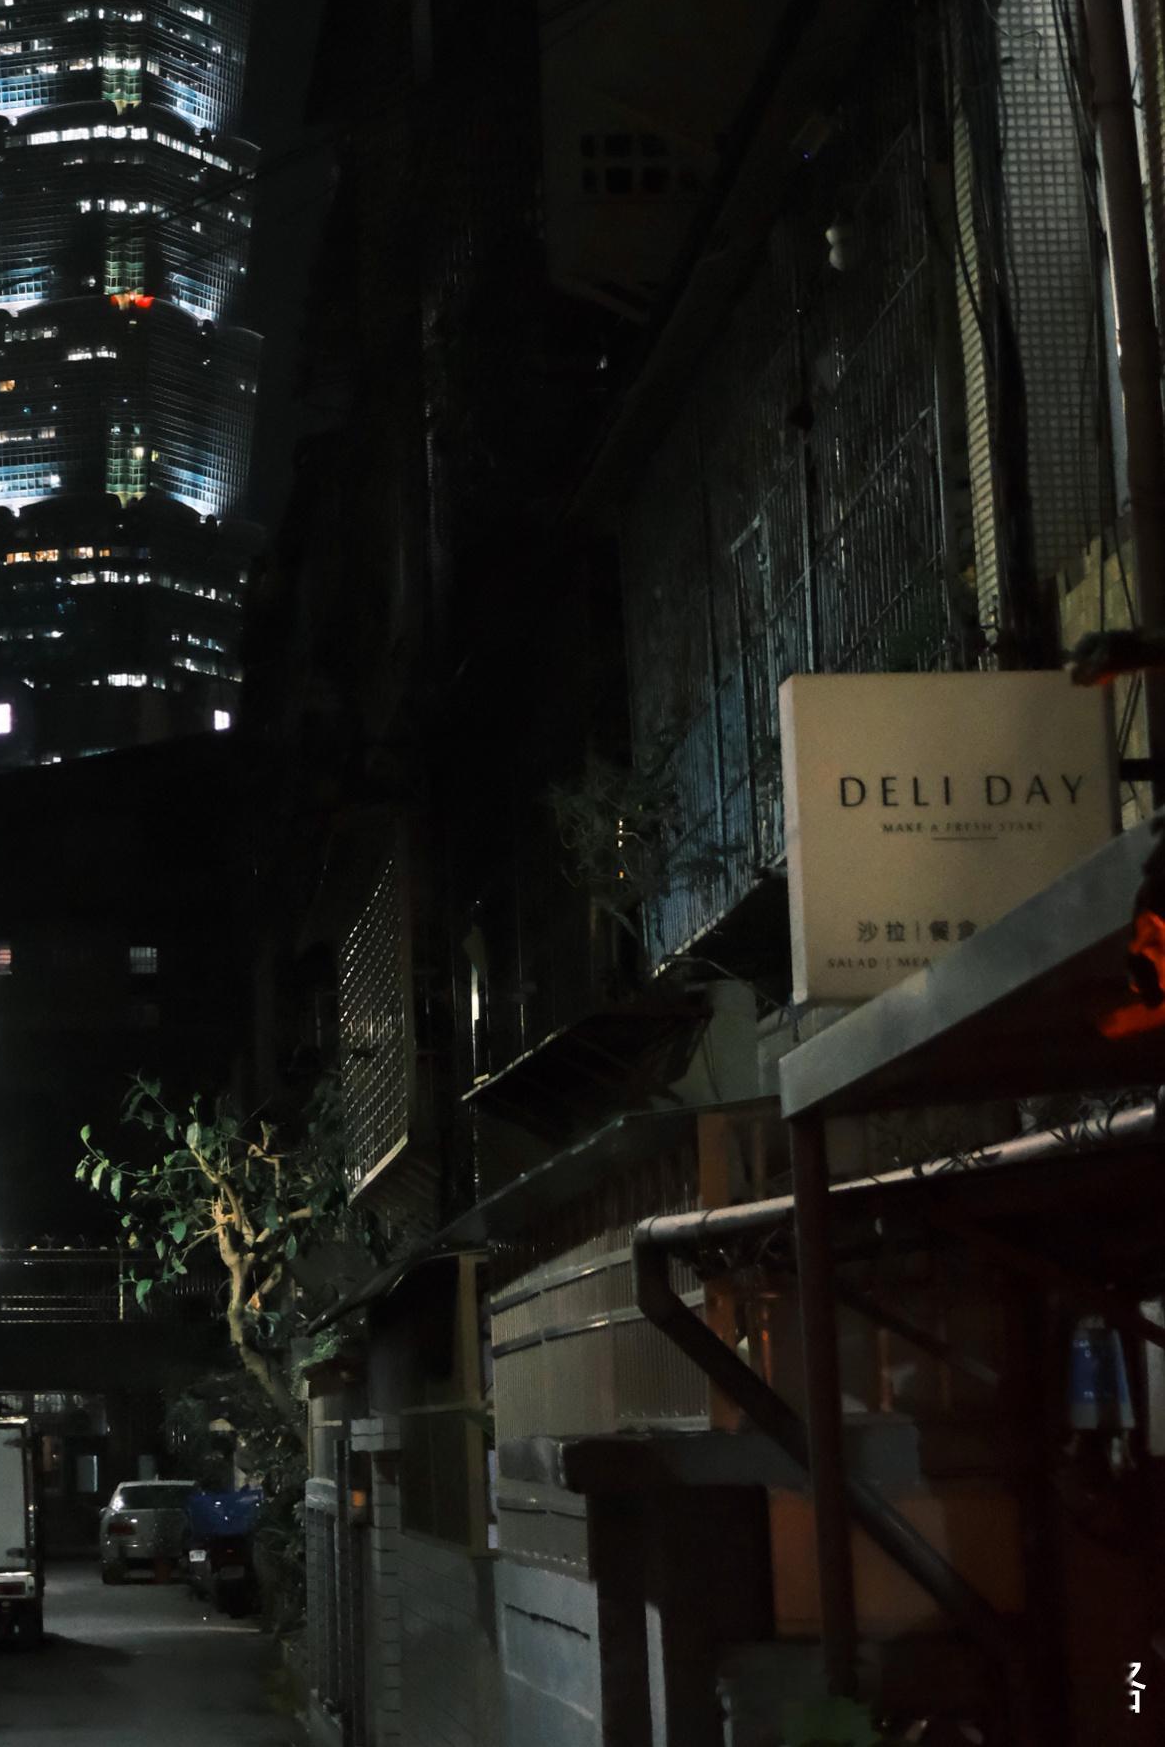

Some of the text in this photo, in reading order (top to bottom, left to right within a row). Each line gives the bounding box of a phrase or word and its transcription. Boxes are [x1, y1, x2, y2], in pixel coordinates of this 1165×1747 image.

[840, 774, 1083, 807] DELI DAY
[882, 822, 923, 833] MAKE
[857, 920, 906, 943] 沙拉
[827, 956, 933, 969] SALAD MEA
